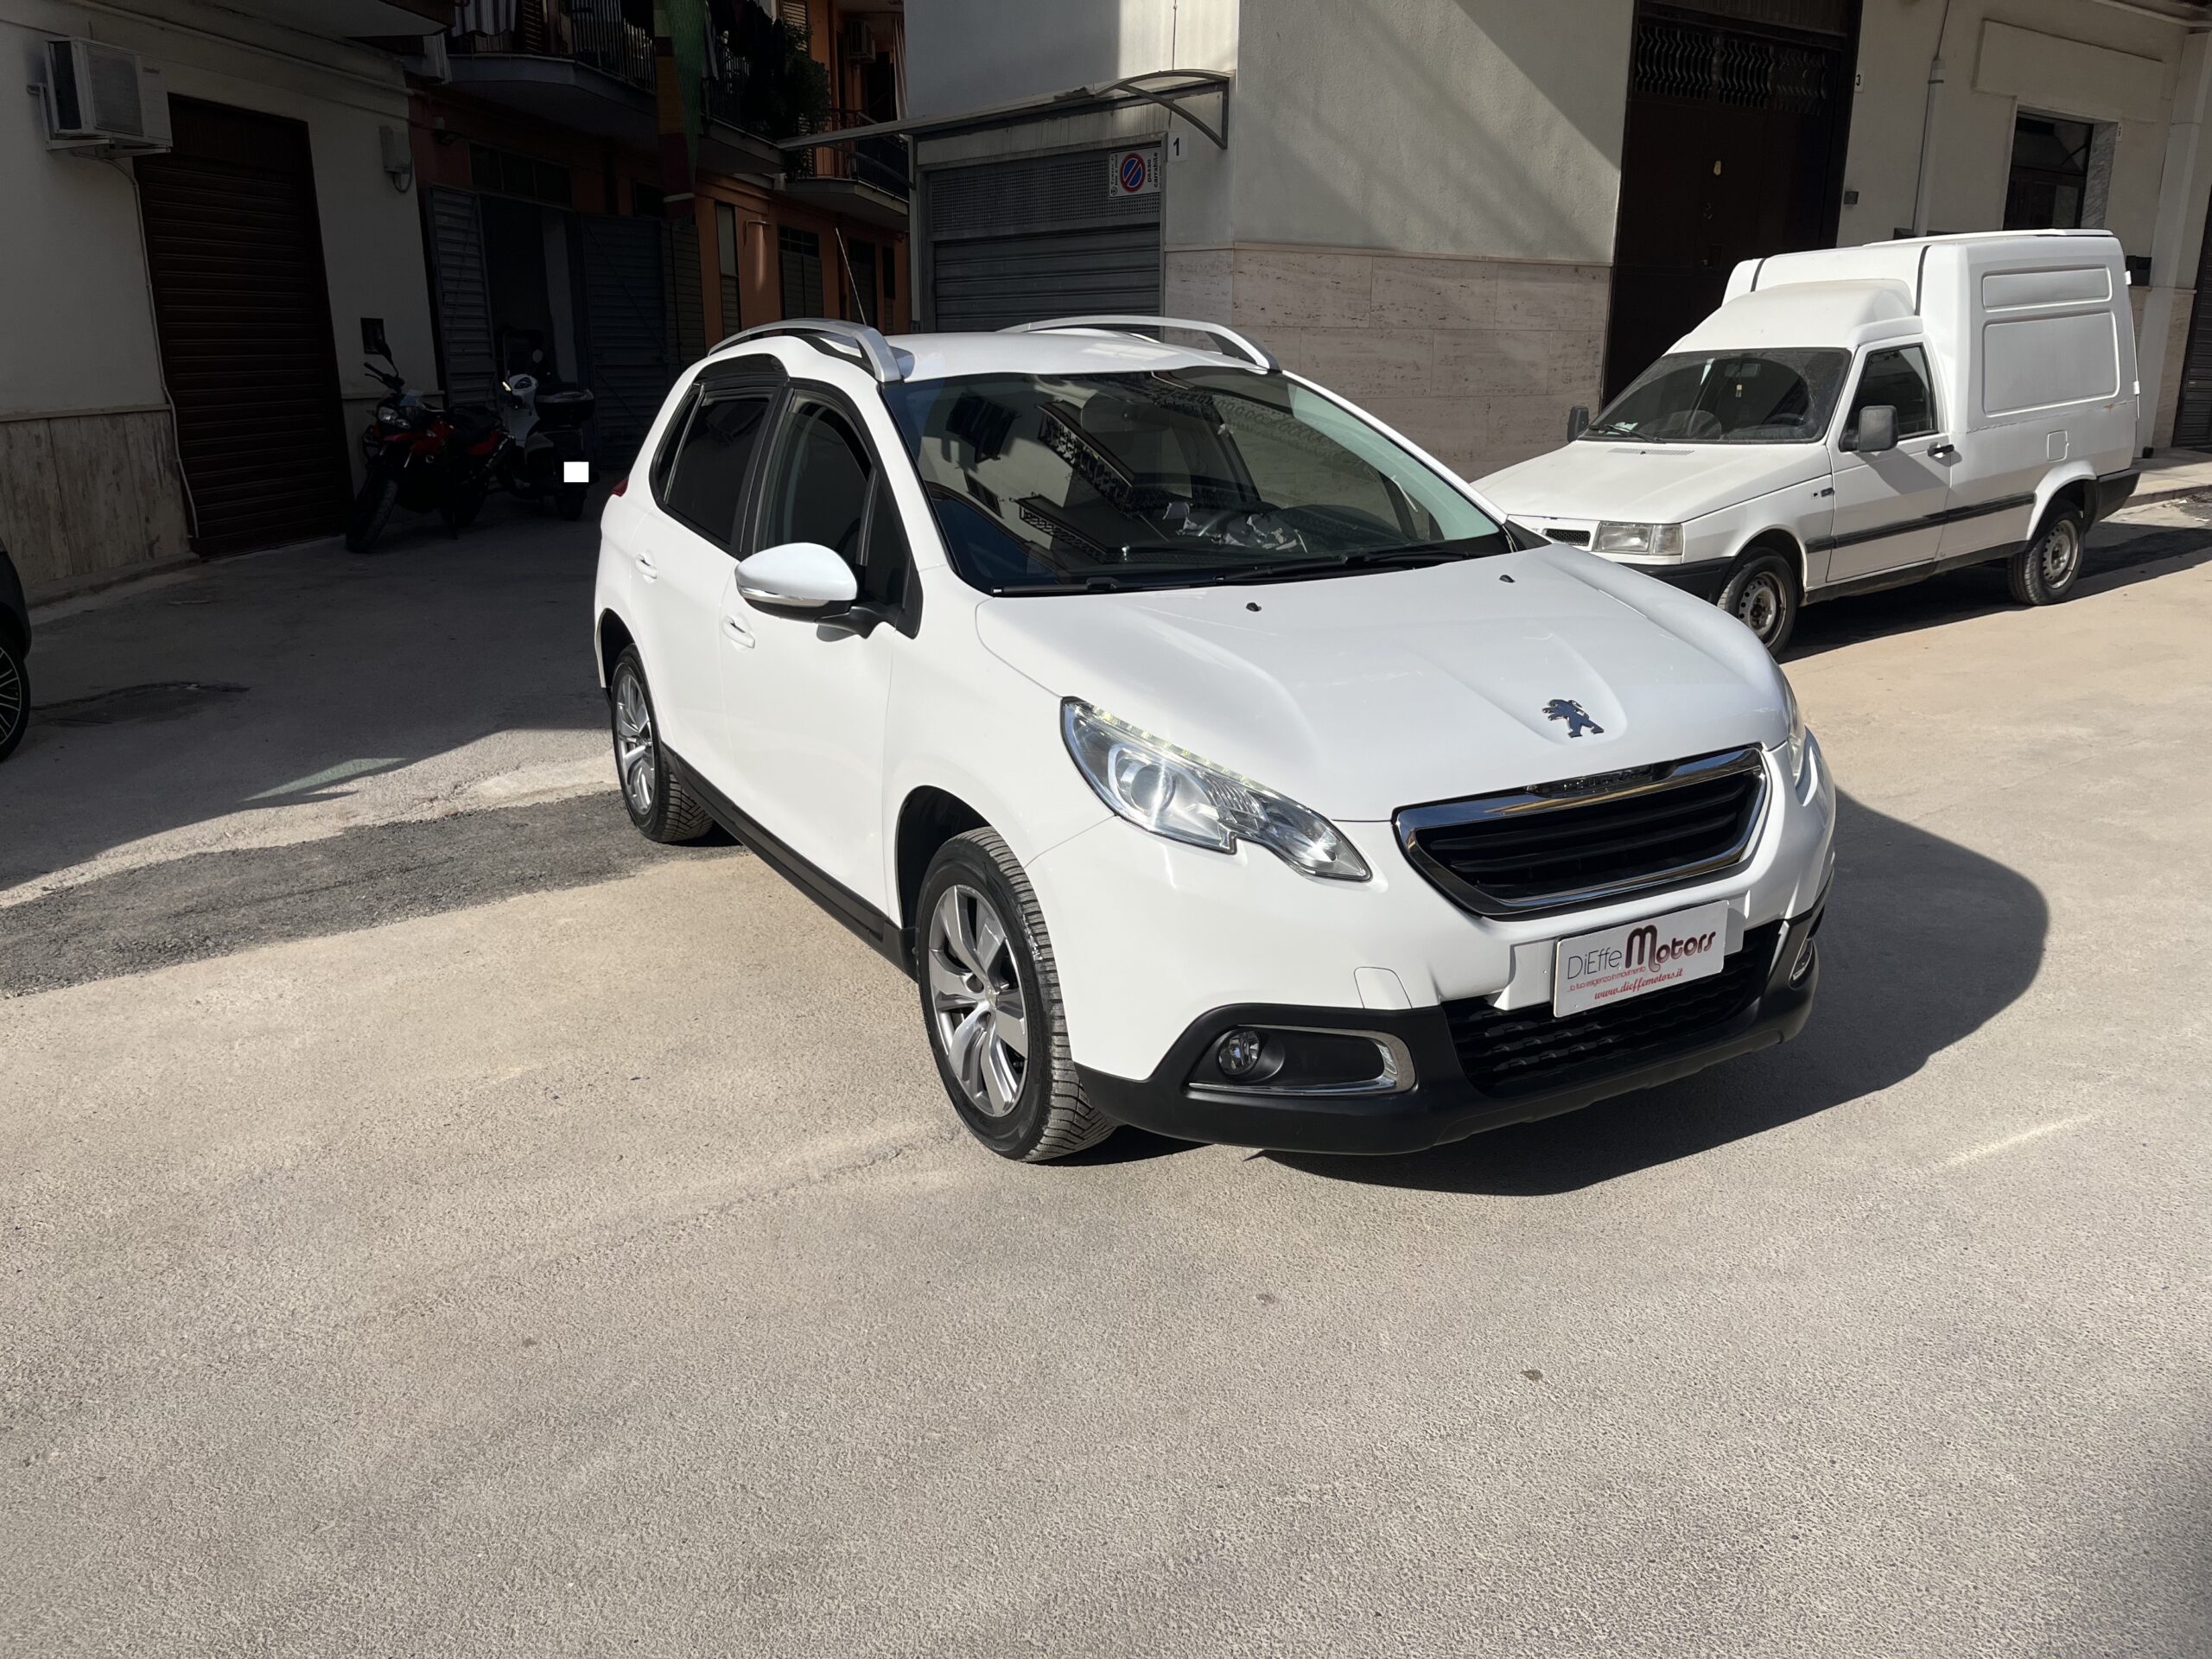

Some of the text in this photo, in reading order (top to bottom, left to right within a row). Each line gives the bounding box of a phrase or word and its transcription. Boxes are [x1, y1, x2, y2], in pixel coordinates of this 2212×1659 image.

[1856, 73, 1861, 86] 3
[1173, 137, 1179, 156] 1
[1567, 925, 1717, 980] DiEffe Motors
[1594, 968, 1684, 1000] www.dieffemotors.it
